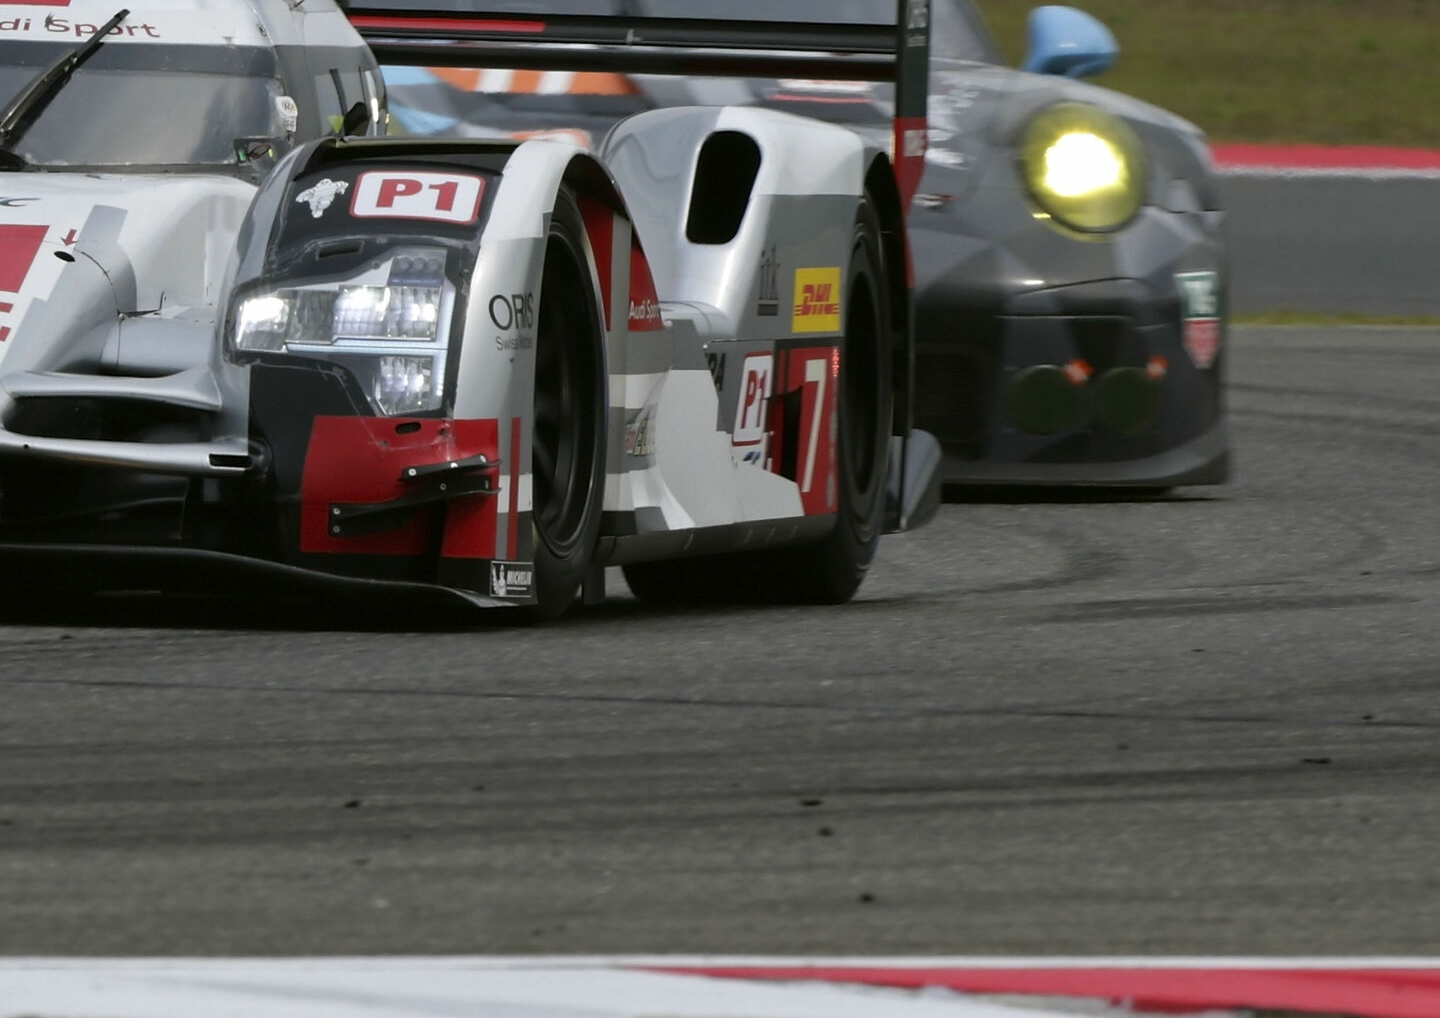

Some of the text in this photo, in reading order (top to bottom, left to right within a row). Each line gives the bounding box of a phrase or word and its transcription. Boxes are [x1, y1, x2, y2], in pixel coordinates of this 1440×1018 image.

[375, 179, 459, 212] P1
[488, 292, 534, 331] ORIS
[801, 283, 834, 316] DHL
[740, 369, 768, 430] P1
[800, 358, 828, 493] 7
